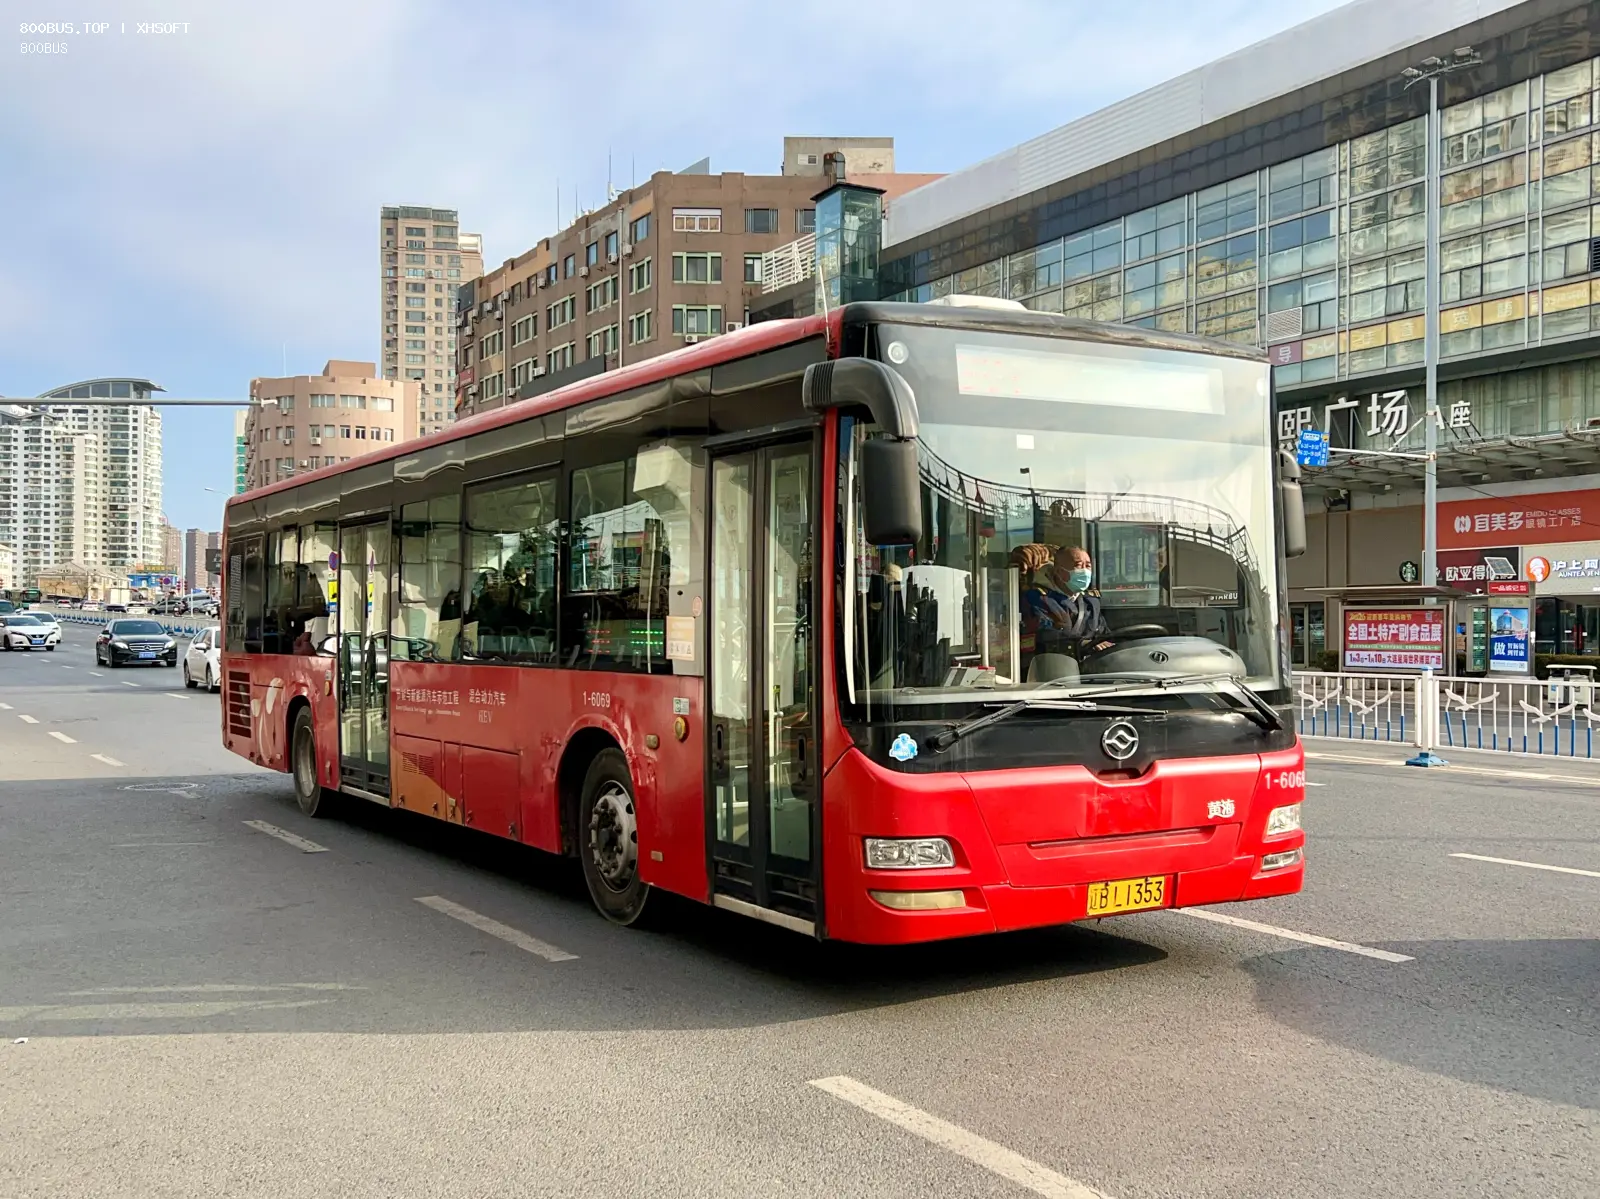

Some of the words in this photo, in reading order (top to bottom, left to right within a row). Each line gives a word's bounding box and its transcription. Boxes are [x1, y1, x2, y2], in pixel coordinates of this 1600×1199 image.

[1473, 511, 1524, 533] 宜美多
[1526, 515, 1581, 529] 眼镜工厂店
[1348, 623, 1442, 642] 全国土特产副食品展
[1494, 642, 1506, 656] 做
[469, 688, 507, 707] 混合动力汽车
[582, 691, 611, 709] 1-6069
[1207, 799, 1236, 819] 黄海
